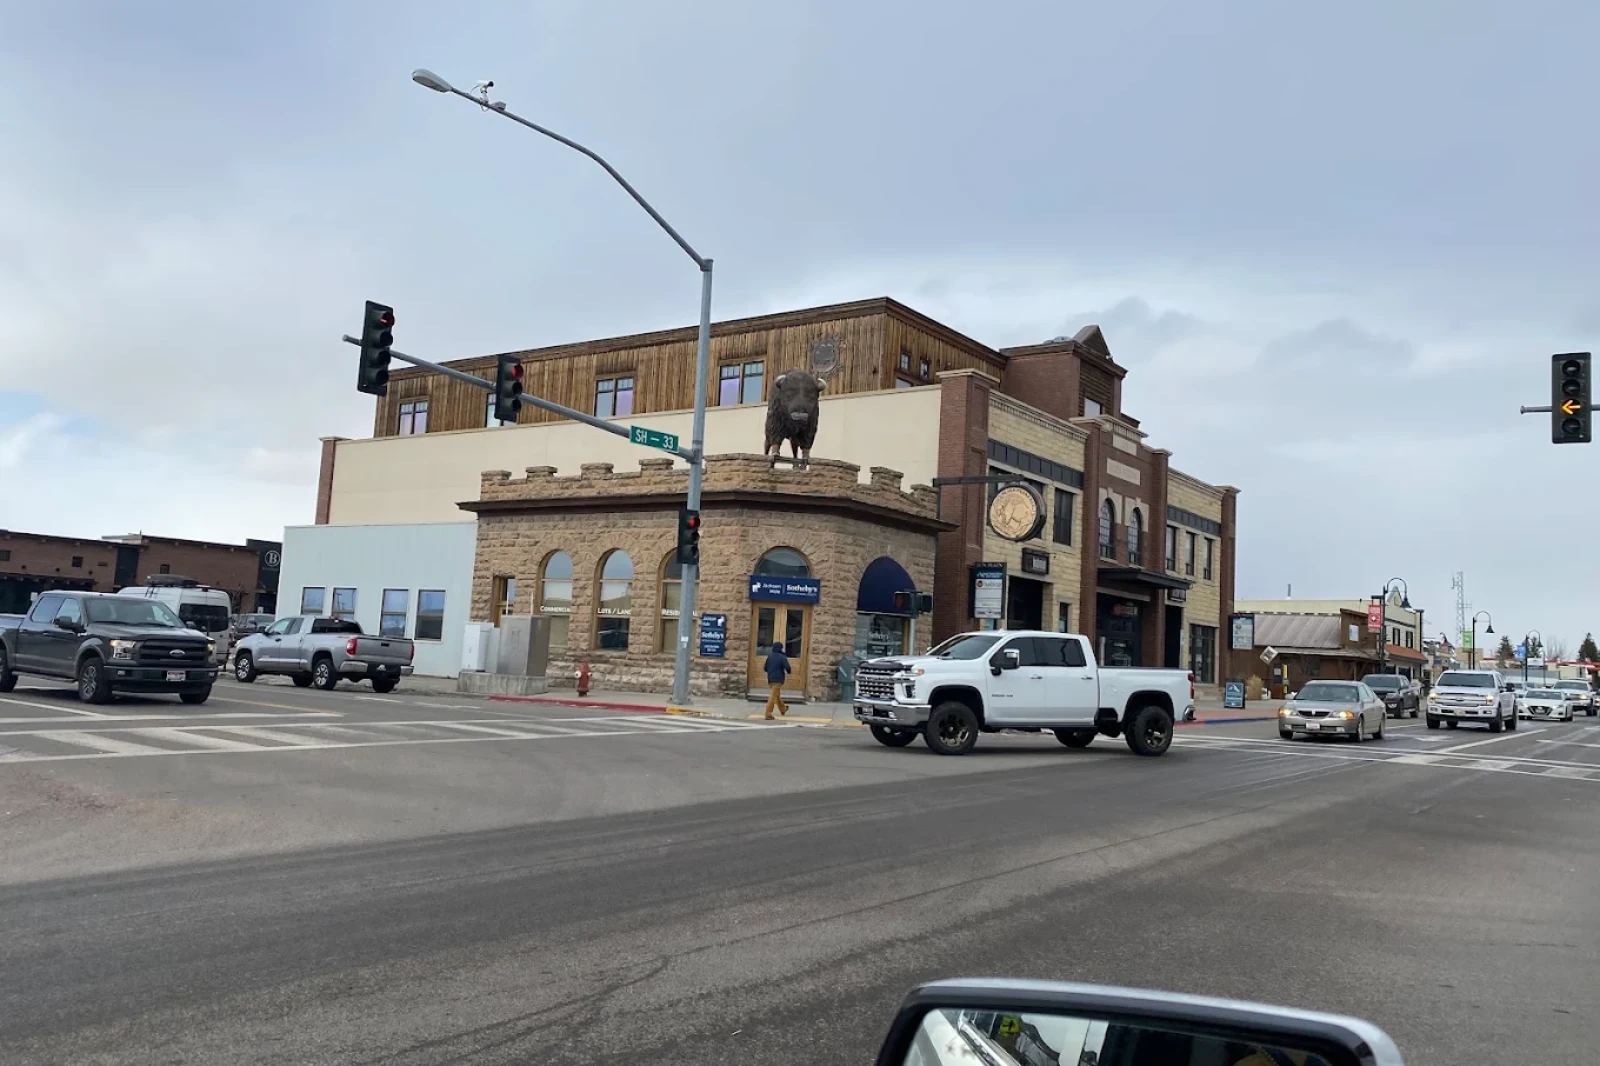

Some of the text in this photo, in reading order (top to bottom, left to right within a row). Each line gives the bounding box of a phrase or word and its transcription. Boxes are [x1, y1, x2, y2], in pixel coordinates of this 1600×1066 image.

[635, 429, 648, 444] SH
[662, 435, 674, 449] 33
[786, 584, 818, 593] Sotheby's
[539, 605, 571, 613] COMMERCIA
